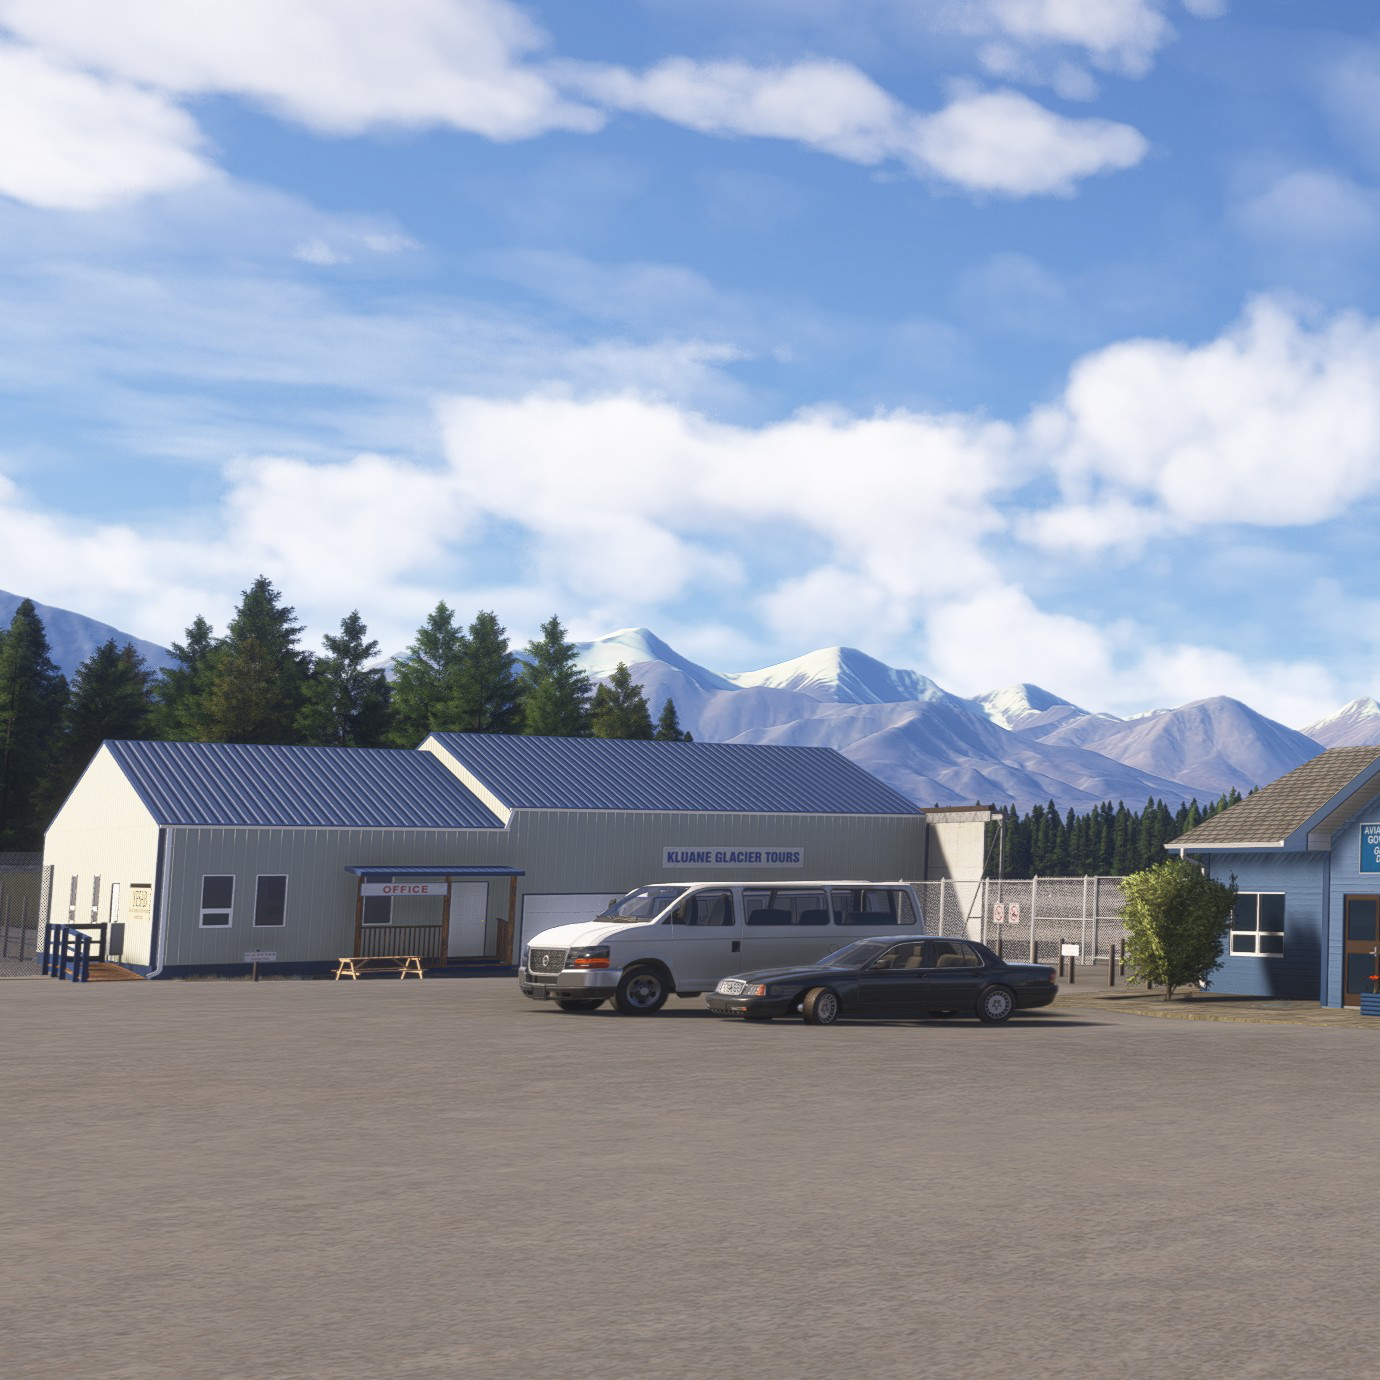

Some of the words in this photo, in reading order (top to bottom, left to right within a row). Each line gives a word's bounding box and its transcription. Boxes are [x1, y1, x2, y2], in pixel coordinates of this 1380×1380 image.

[667, 852, 712, 863] KLUANE
[715, 852, 762, 863] GLACIER
[765, 852, 800, 863] TOURS
[383, 886, 429, 894] OFFICE
